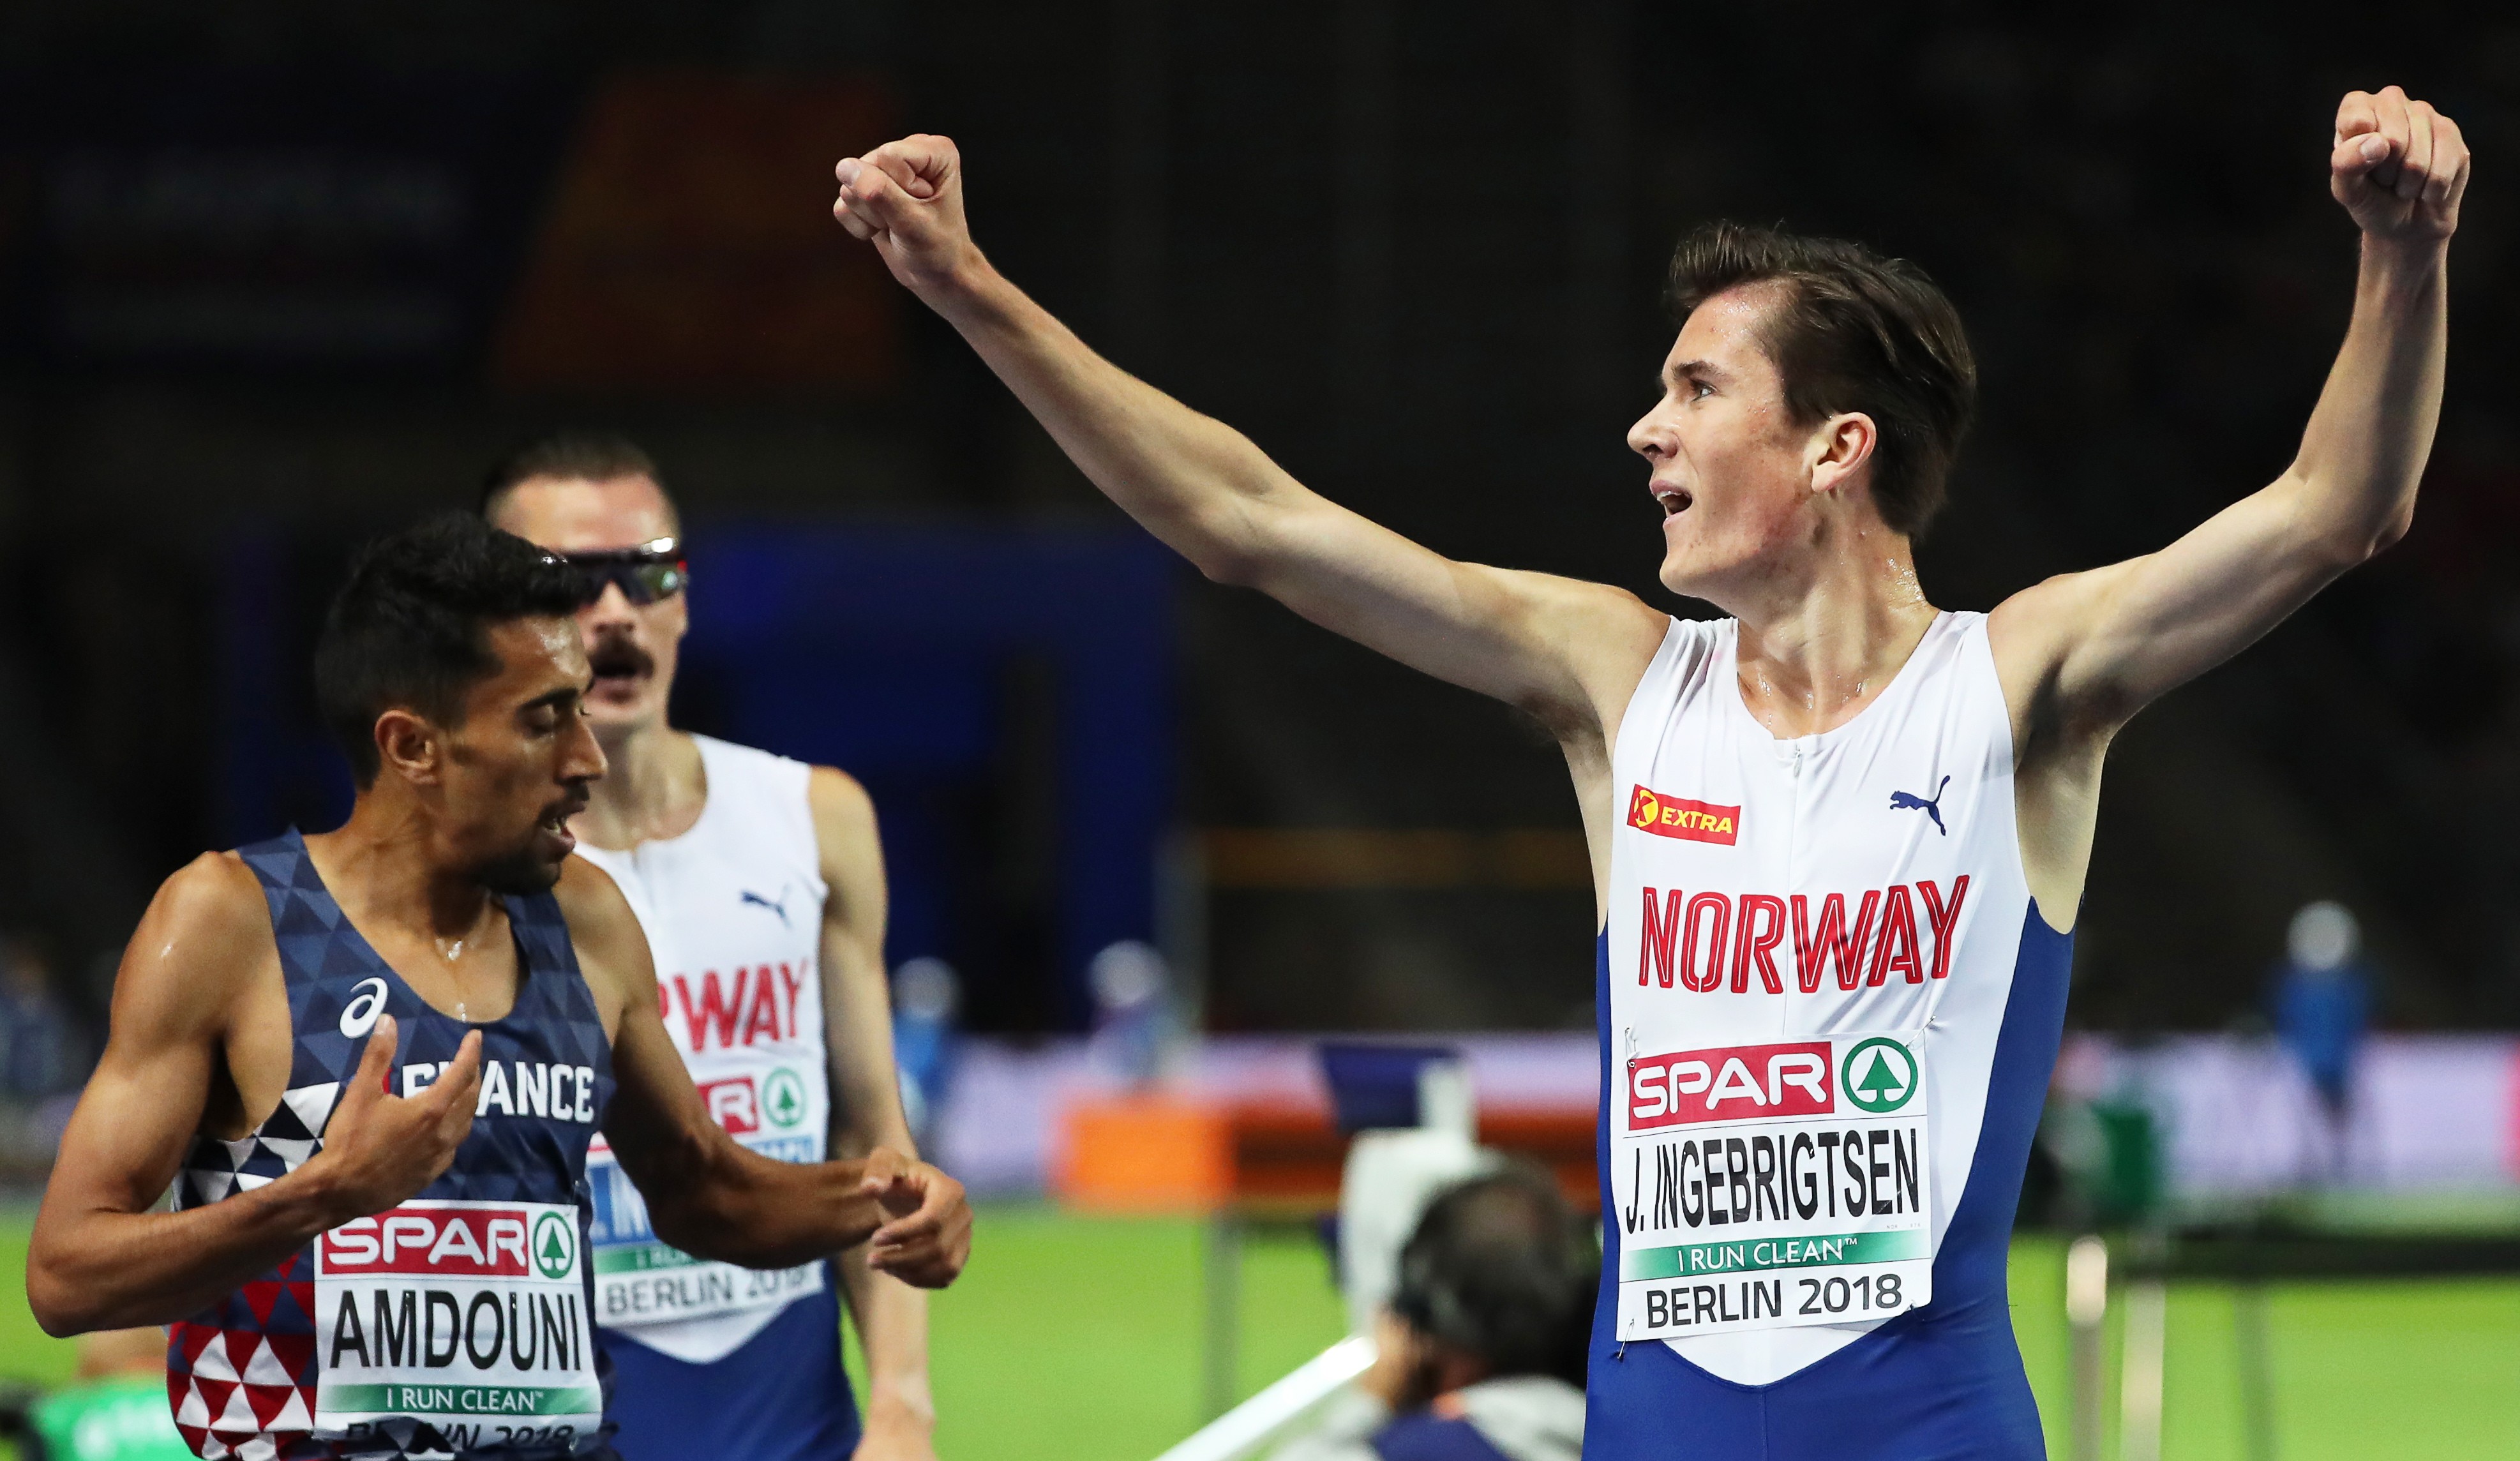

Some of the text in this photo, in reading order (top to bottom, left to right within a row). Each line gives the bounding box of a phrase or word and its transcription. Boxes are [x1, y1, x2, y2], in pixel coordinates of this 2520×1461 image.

[1661, 806, 1732, 834] EXTRA
[1639, 874, 1970, 994] NORWAY
[657, 959, 808, 1051] WAY
[403, 1060, 595, 1123] FANCE
[1633, 1053, 1827, 1119] SPAR
[1626, 1128, 1919, 1234] J. INGEBRIGTSEN
[327, 1216, 527, 1266] SPAR
[1678, 1250, 1684, 1272] I
[1691, 1245, 1745, 1271] RUN
[607, 1270, 733, 1315] BERLIN
[1646, 1273, 1903, 1329] BERLIN 2018
[329, 1289, 581, 1371] AMDOUNI
[387, 1388, 393, 1409] I
[401, 1388, 454, 1410] RUN
